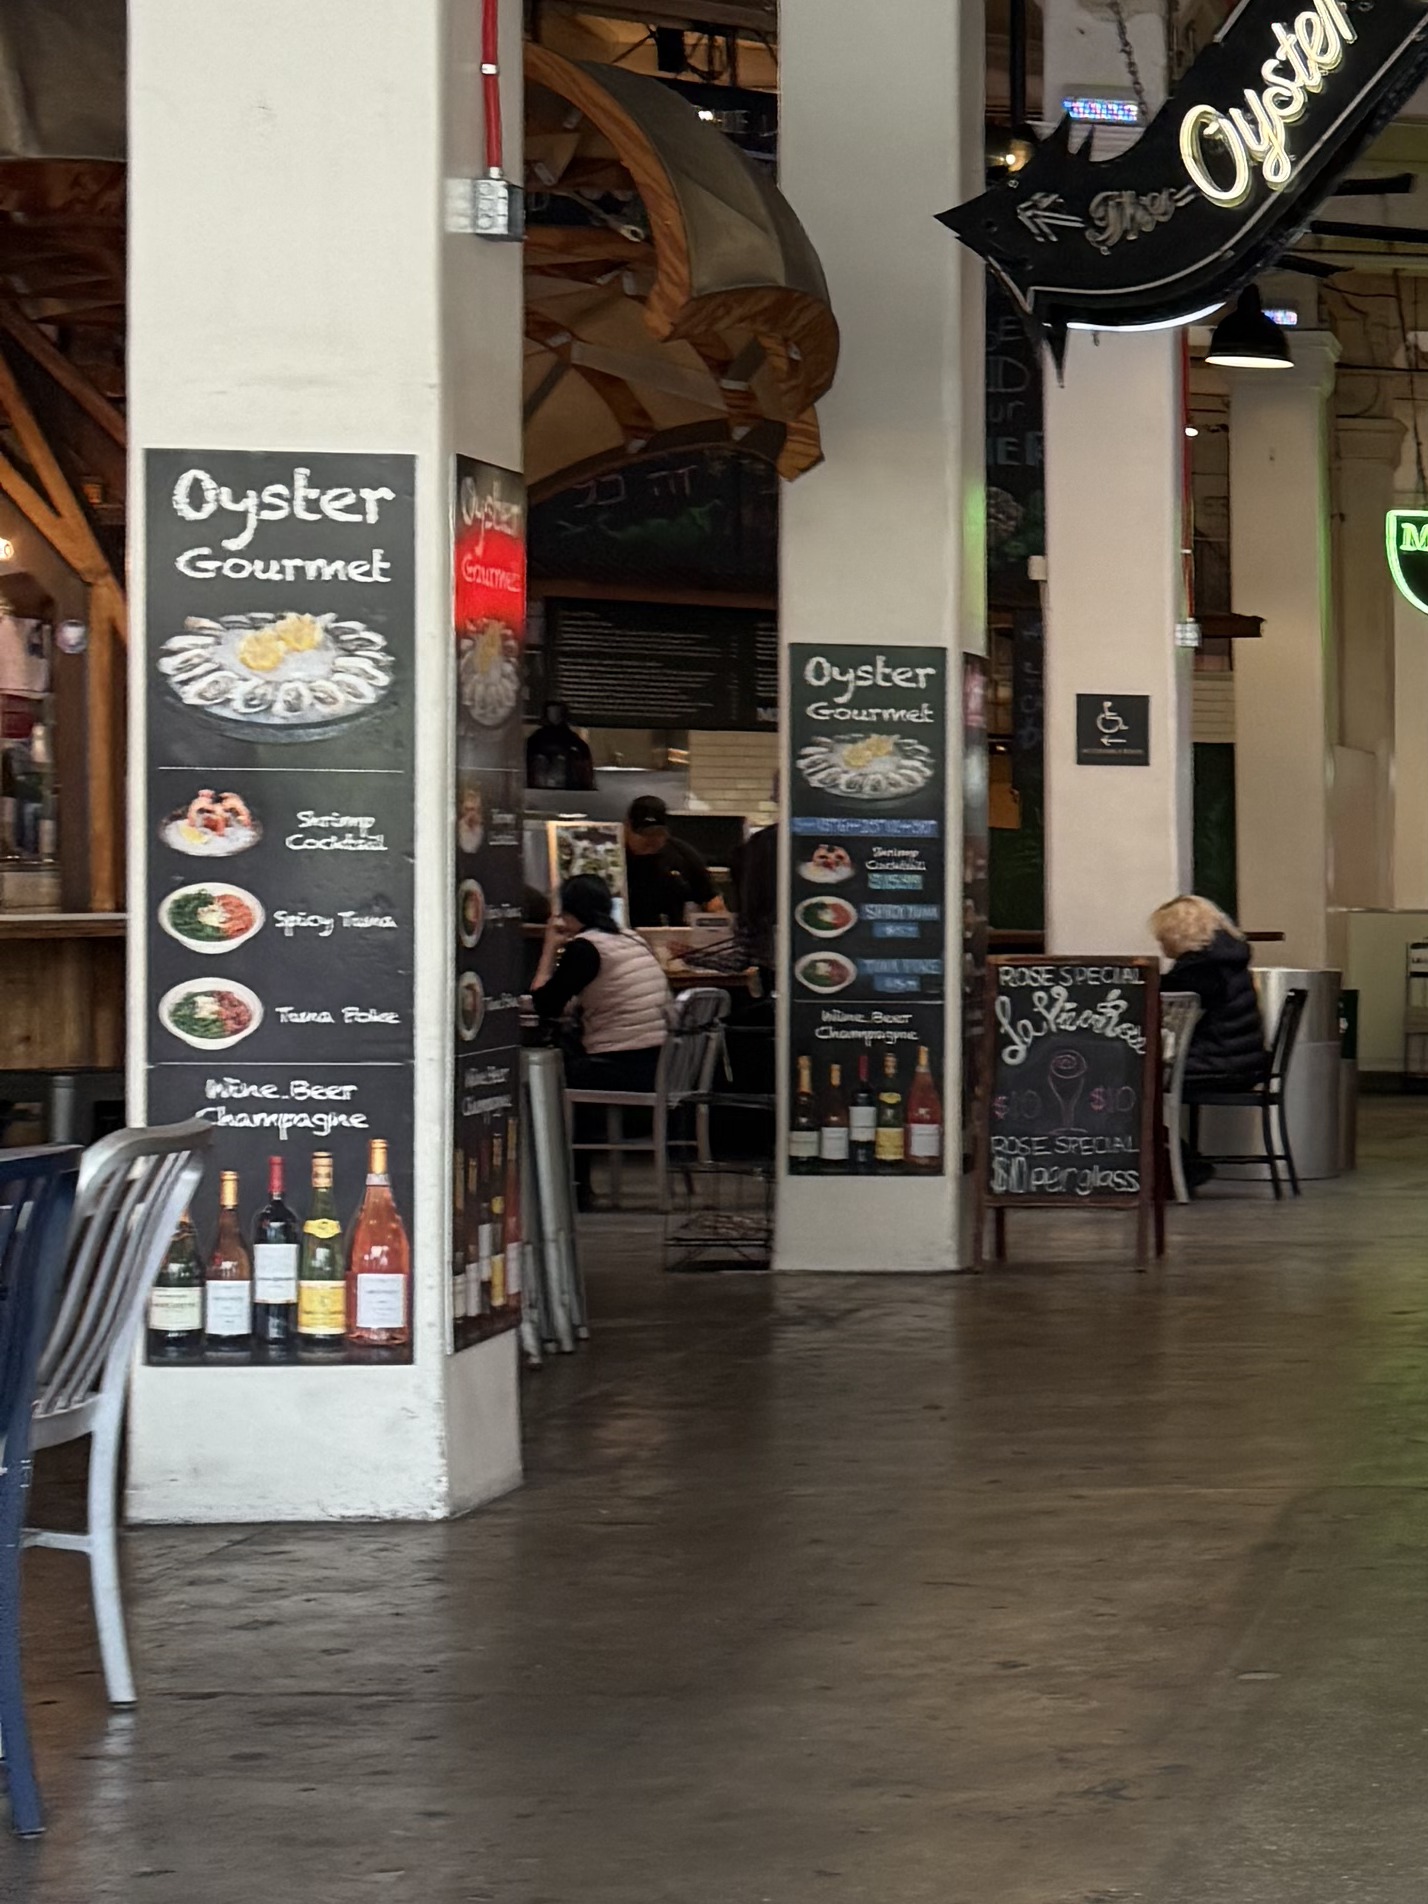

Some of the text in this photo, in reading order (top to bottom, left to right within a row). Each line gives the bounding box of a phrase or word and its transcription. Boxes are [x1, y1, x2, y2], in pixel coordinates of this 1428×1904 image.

[172, 467, 396, 551] Oyster
[175, 547, 392, 583] Gourmet
[803, 655, 936, 704] Oyster
[806, 702, 935, 723] Gourmet
[296, 810, 377, 838] Shrimp
[273, 910, 398, 937] Spicy Tuna
[999, 966, 1146, 987] ROSE SPECIAL
[275, 1006, 335, 1024] Tuna
[194, 1107, 370, 1141] Champagne
[990, 1136, 1140, 1155] ROSE SPECIAL
[1075, 1165, 1140, 1196] glass
